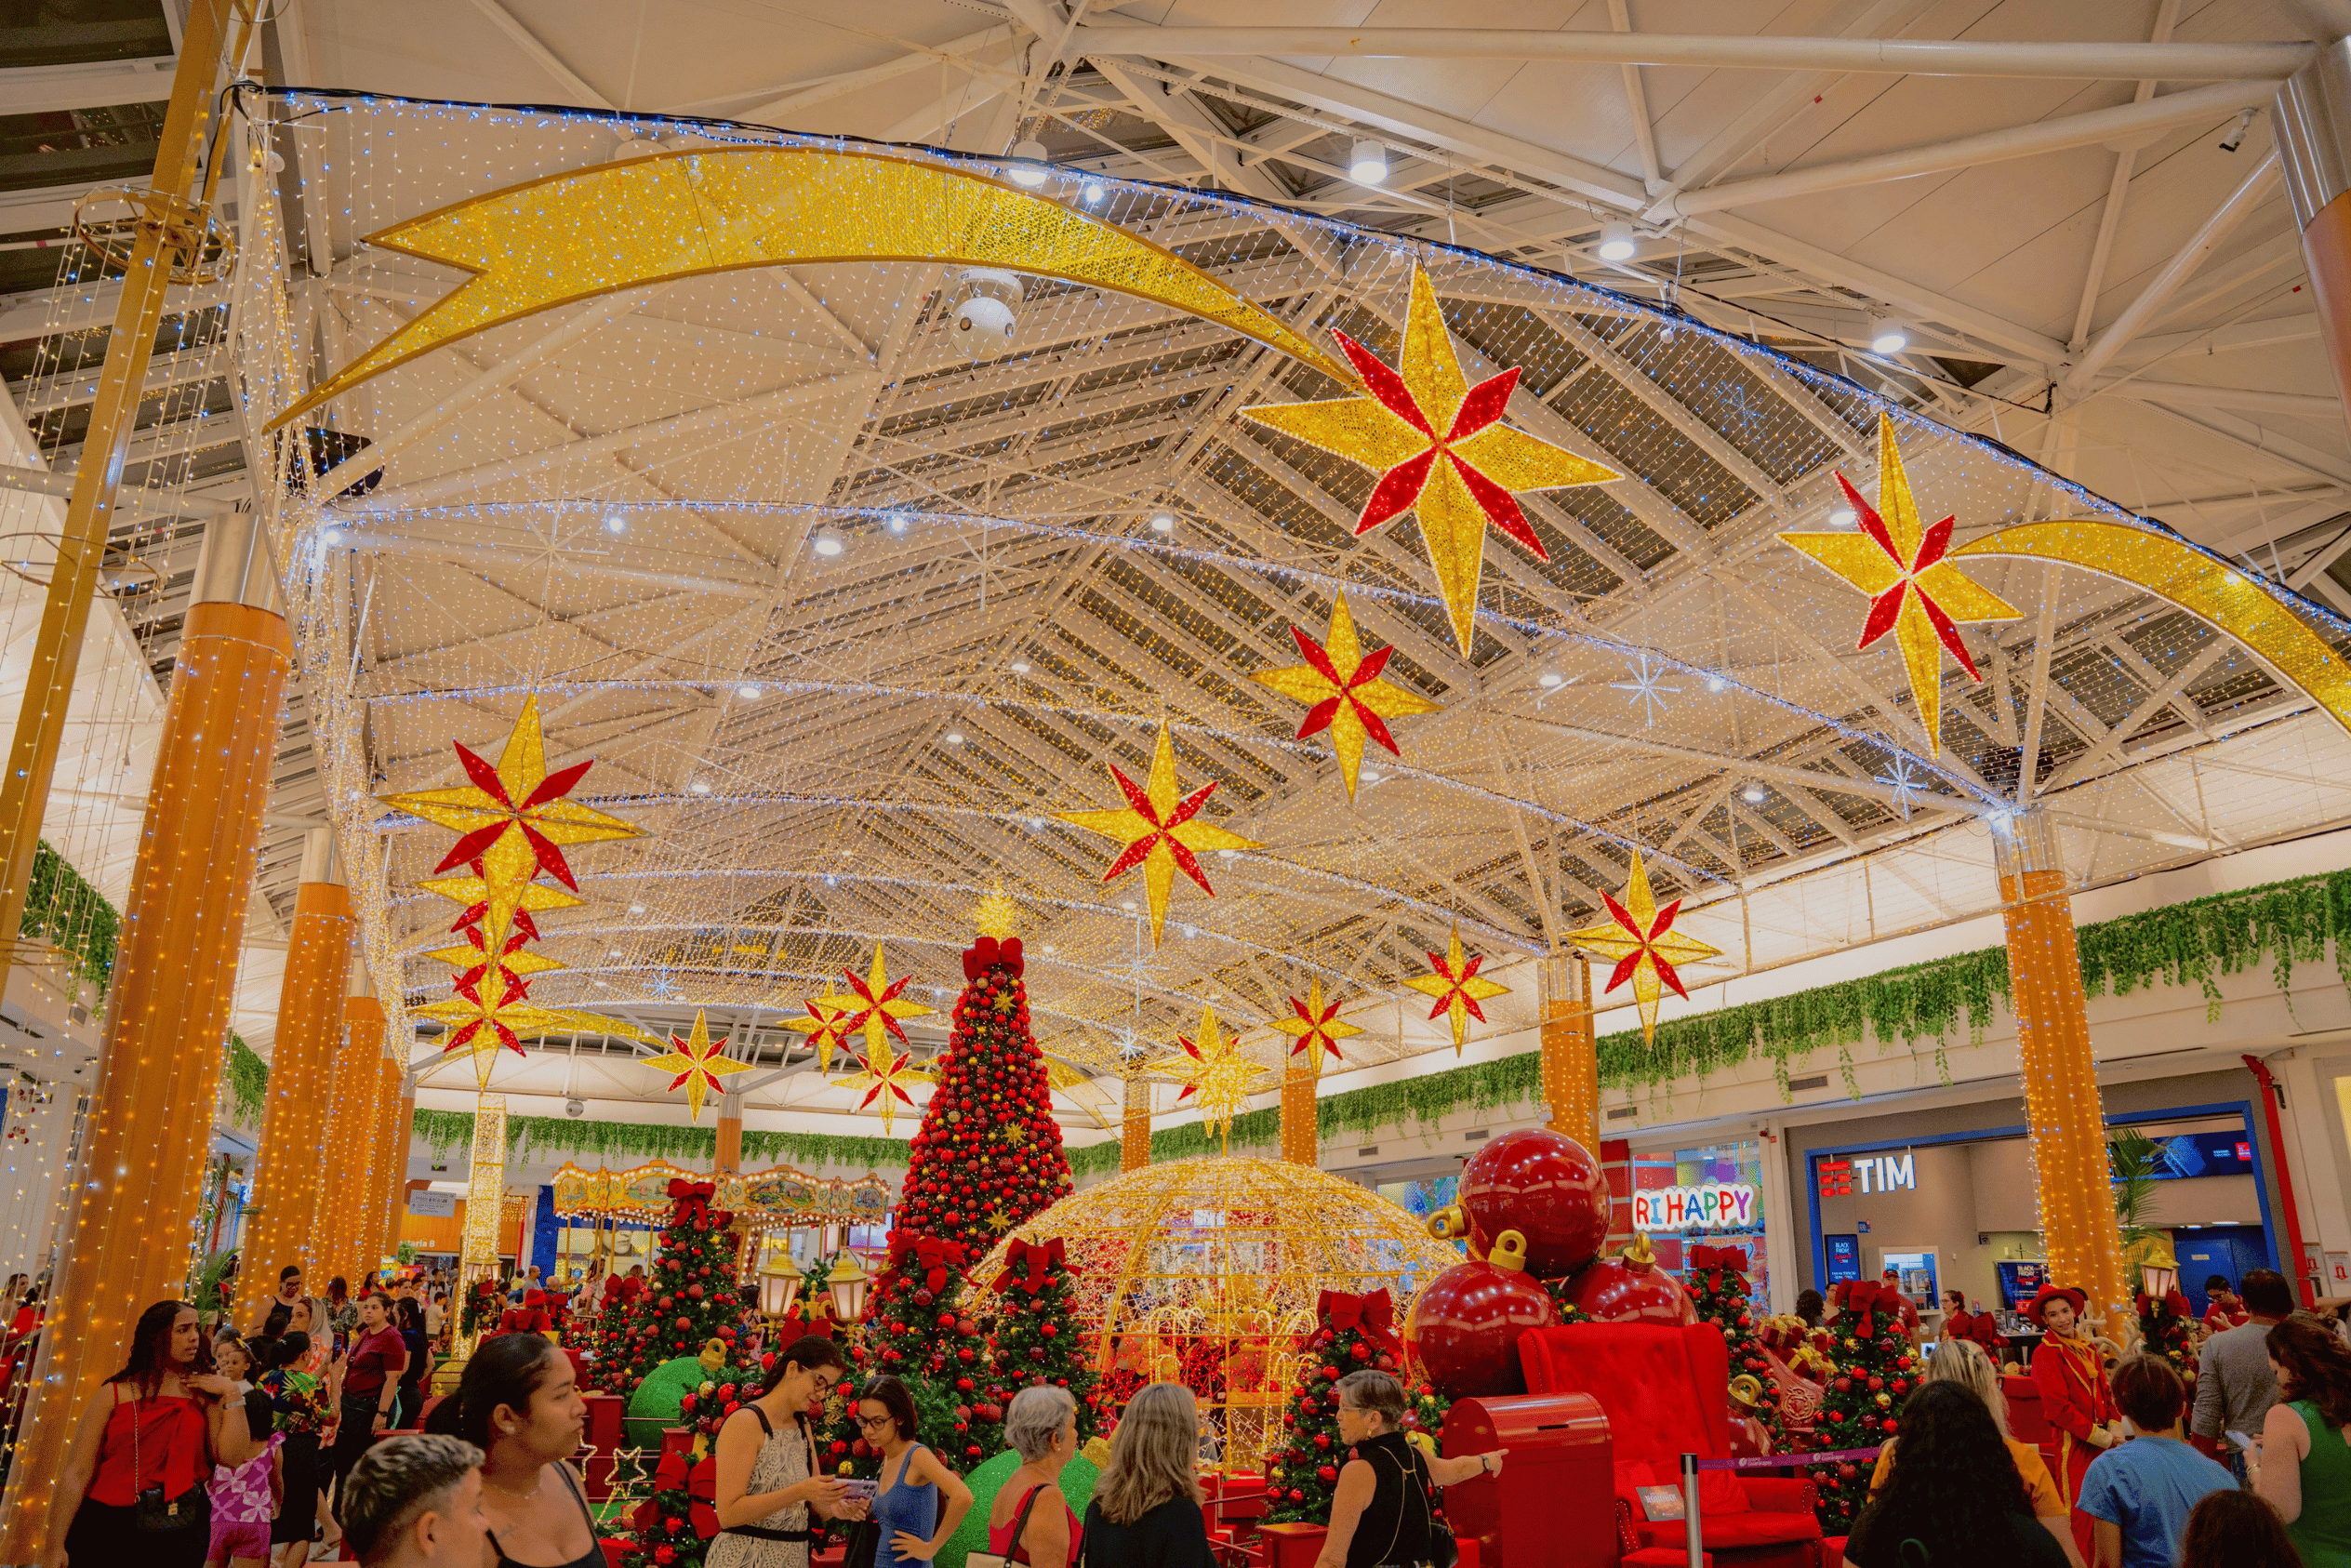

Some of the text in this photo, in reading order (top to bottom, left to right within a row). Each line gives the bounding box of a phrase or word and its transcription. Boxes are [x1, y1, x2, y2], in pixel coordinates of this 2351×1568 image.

[1854, 1155, 1916, 1194] TIM
[1636, 1190, 1749, 1225] RI HAPPY
